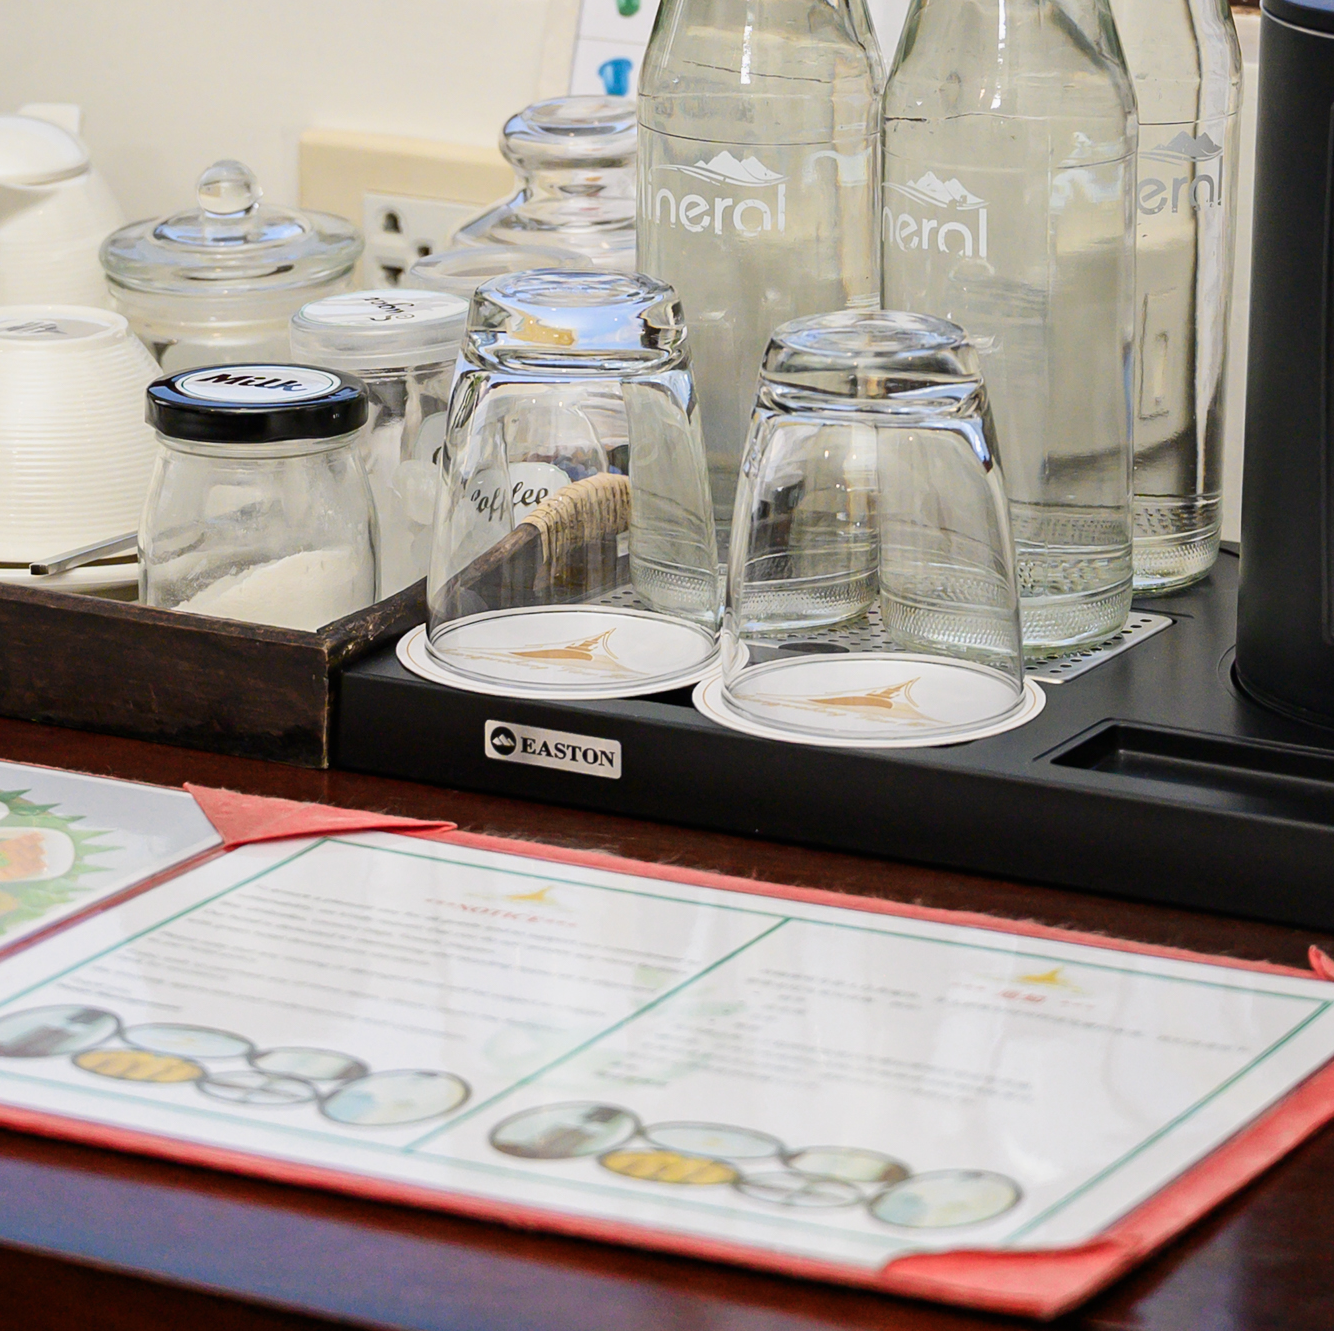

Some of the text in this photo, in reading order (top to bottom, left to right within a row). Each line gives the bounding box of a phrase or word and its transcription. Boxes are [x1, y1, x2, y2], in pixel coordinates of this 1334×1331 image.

[639, 171, 787, 238] ineral
[195, 372, 308, 394] Milk
[520, 736, 616, 768] EASTON
